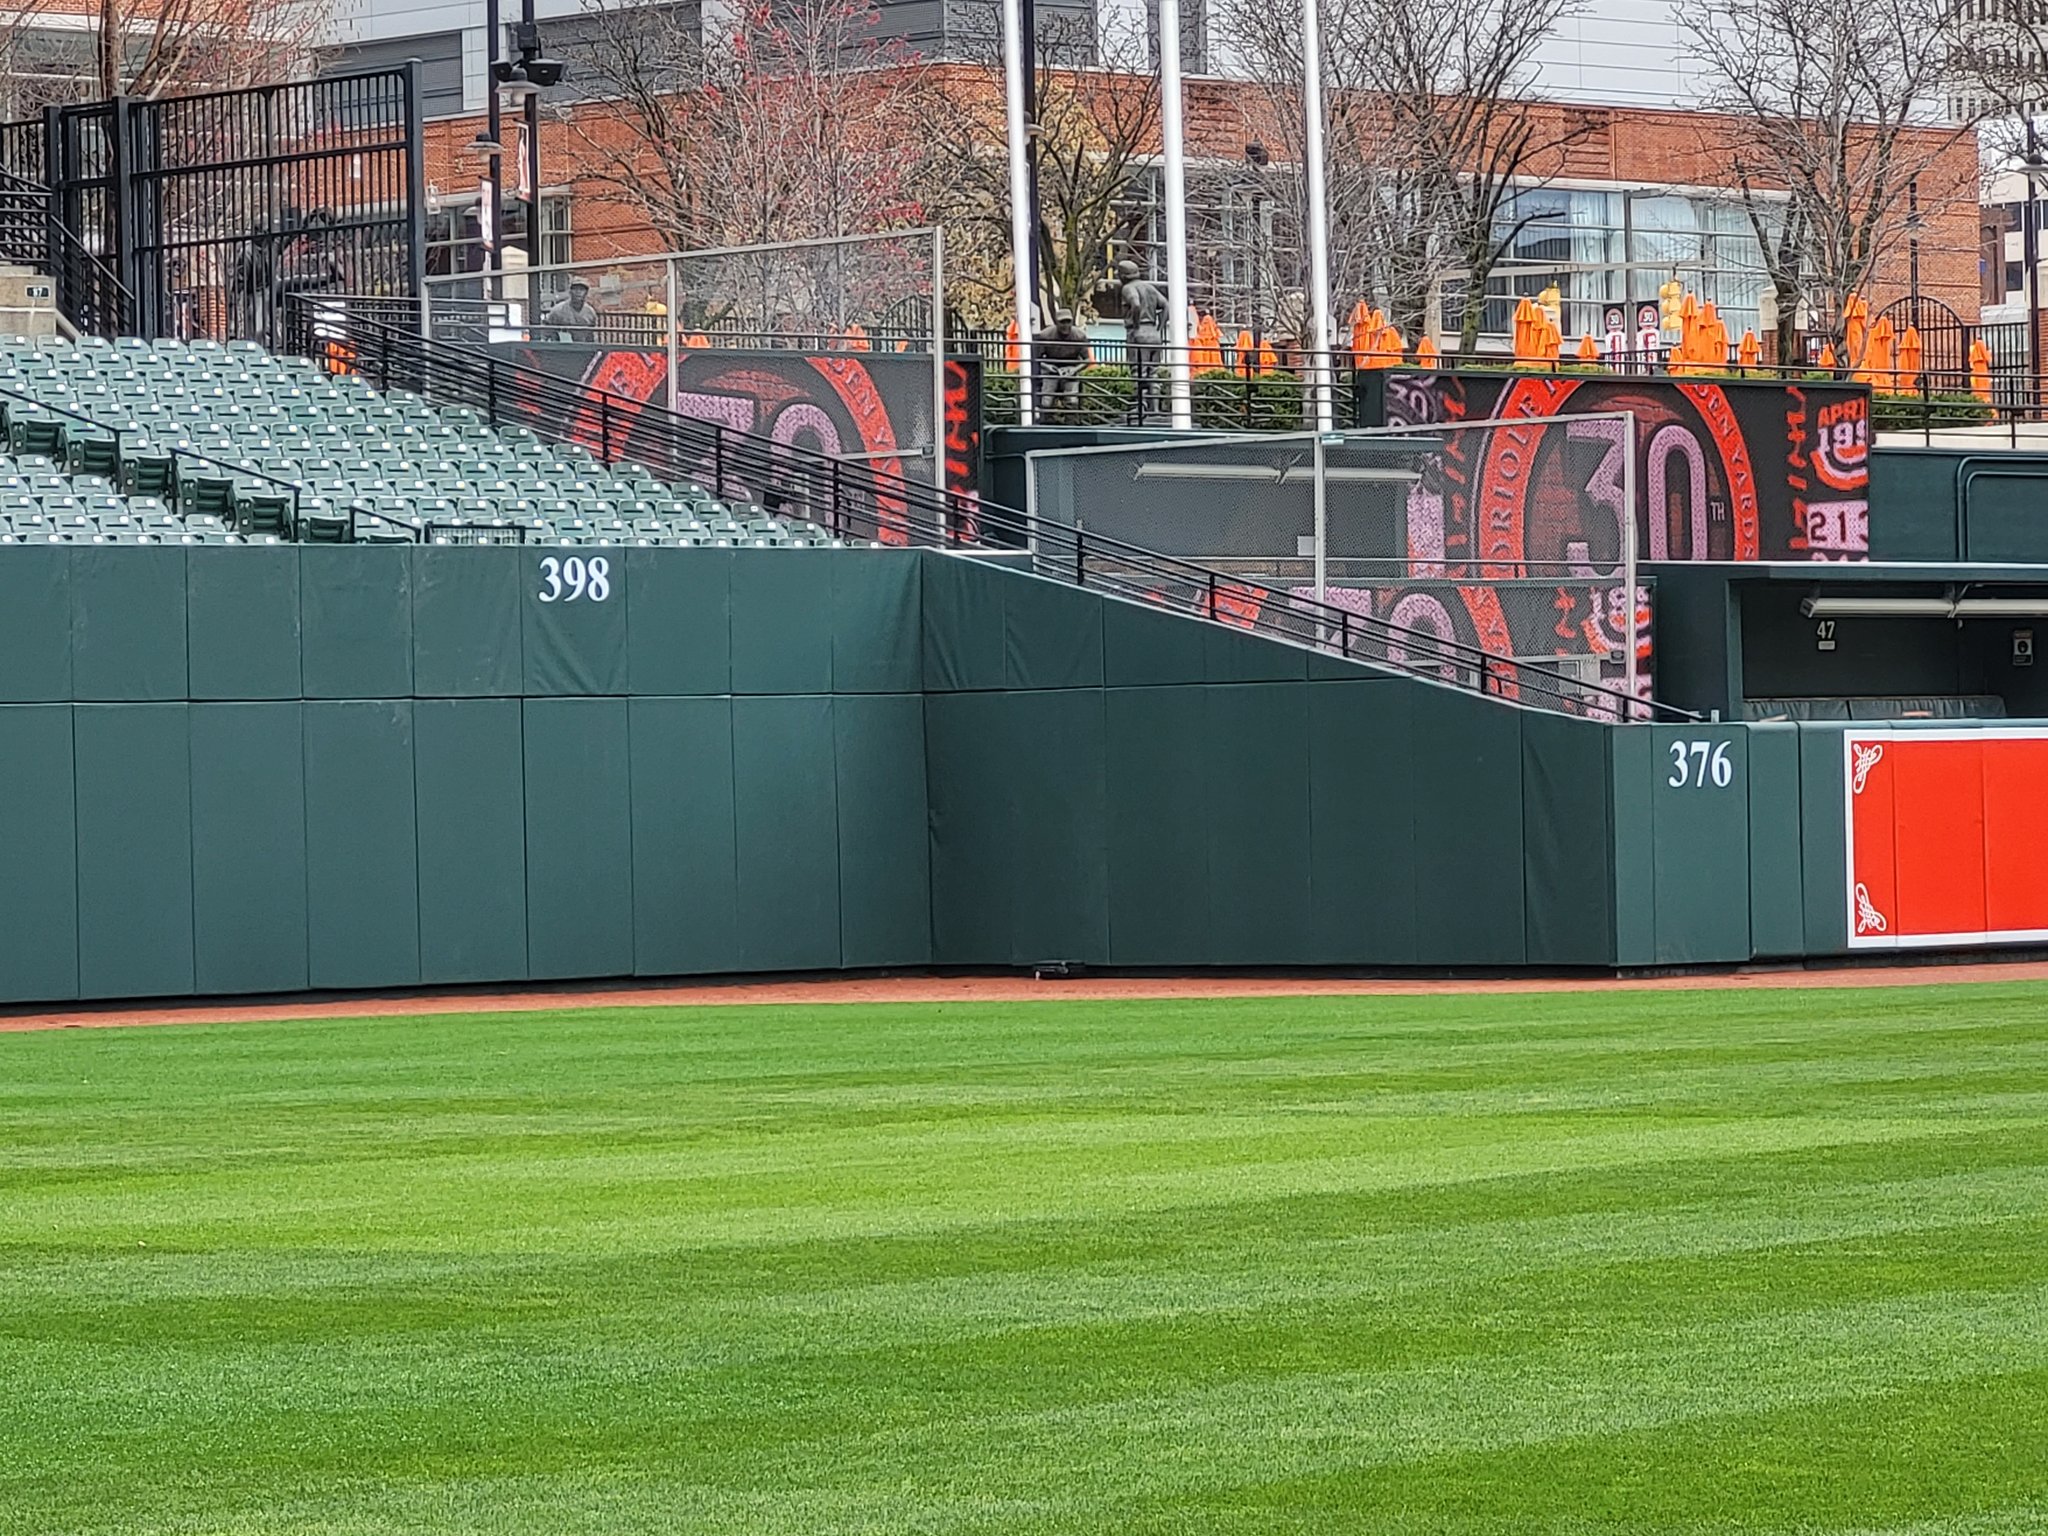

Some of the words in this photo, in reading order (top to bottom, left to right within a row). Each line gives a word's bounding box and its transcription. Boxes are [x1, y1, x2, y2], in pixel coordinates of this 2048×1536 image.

[1710, 501, 1726, 522] TH
[538, 556, 611, 602] 398
[1816, 620, 1836, 640] 47
[1667, 739, 1733, 789] 376
